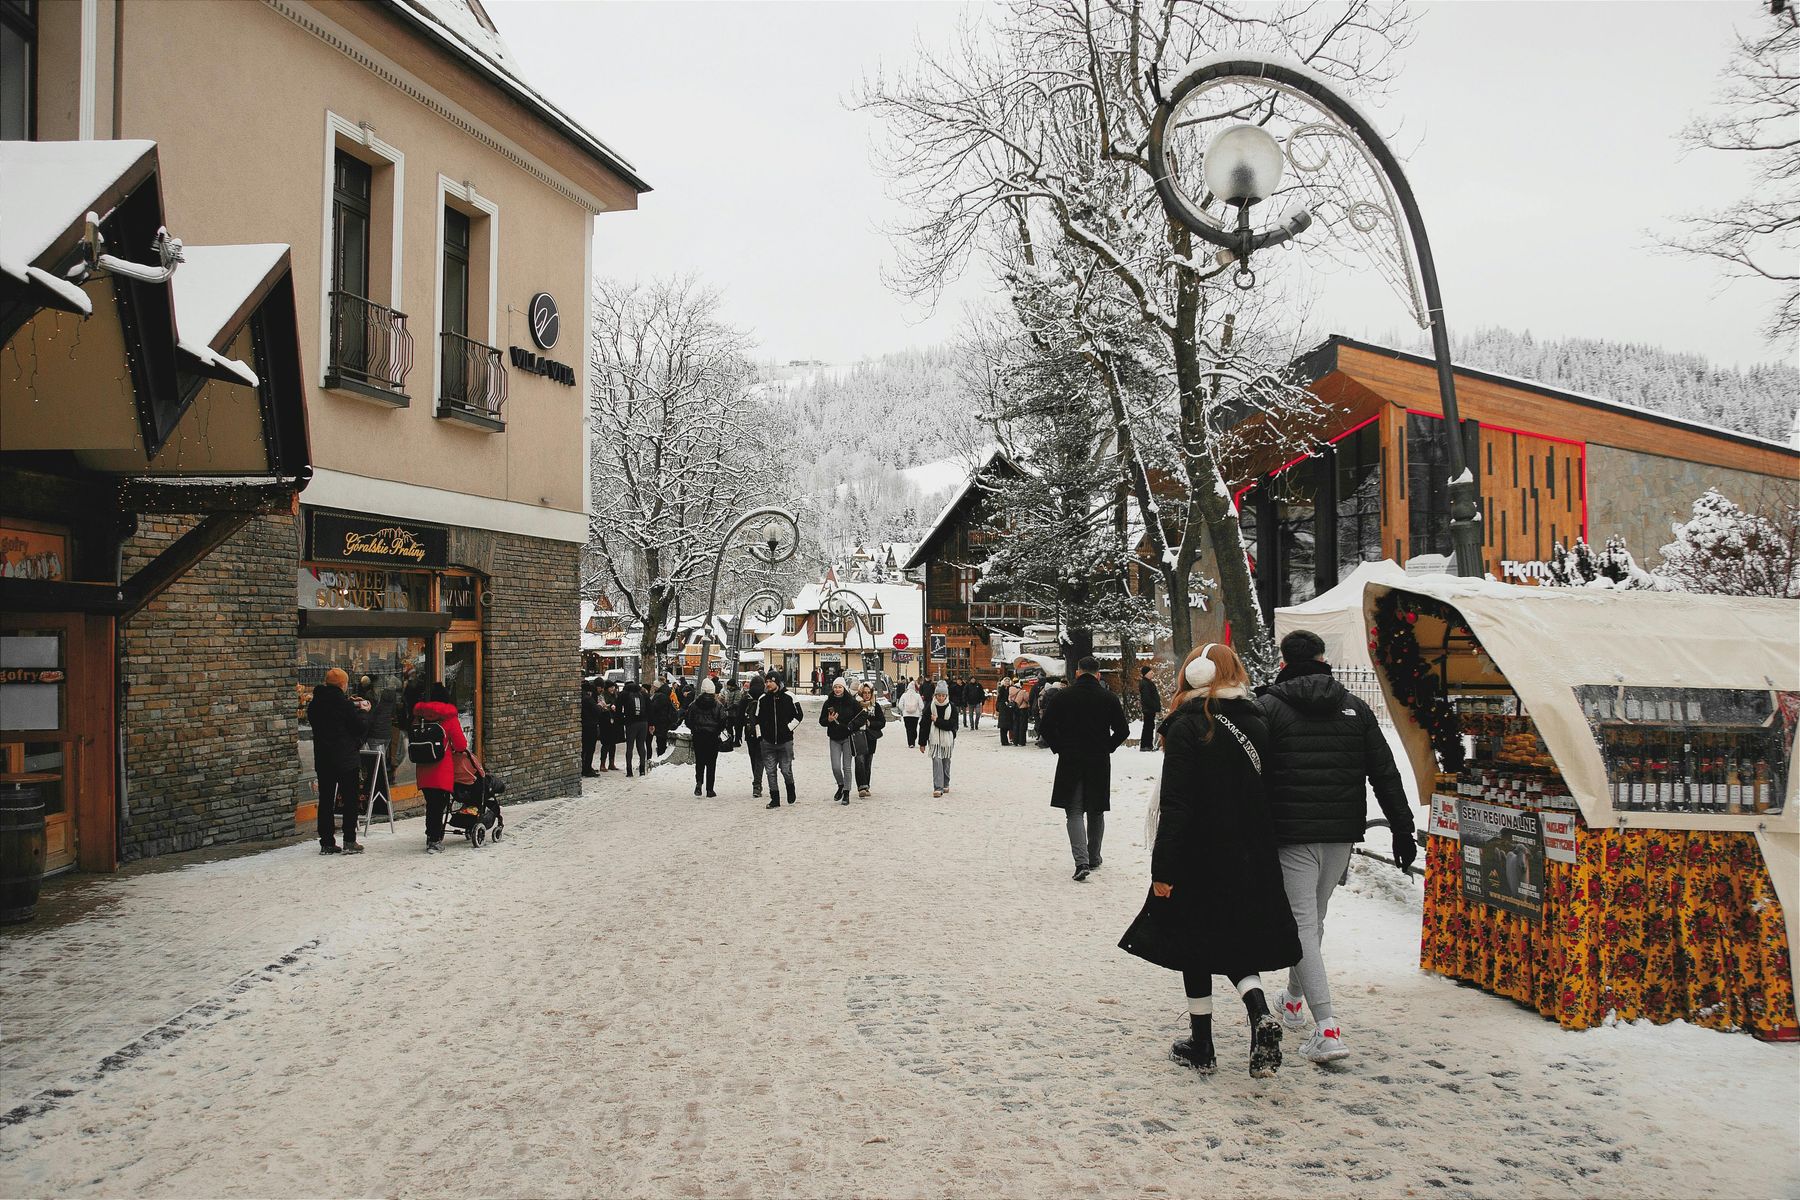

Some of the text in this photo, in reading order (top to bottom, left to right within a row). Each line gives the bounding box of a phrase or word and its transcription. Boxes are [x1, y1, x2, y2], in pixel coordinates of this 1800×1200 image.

[342, 532, 426, 562] Góralskie Praliny
[336, 570, 392, 590] SWEET
[315, 588, 409, 609] SOUVENIRS
[0, 669, 38, 683] gofry
[1462, 806, 1537, 834] SERY REGIONALNE
